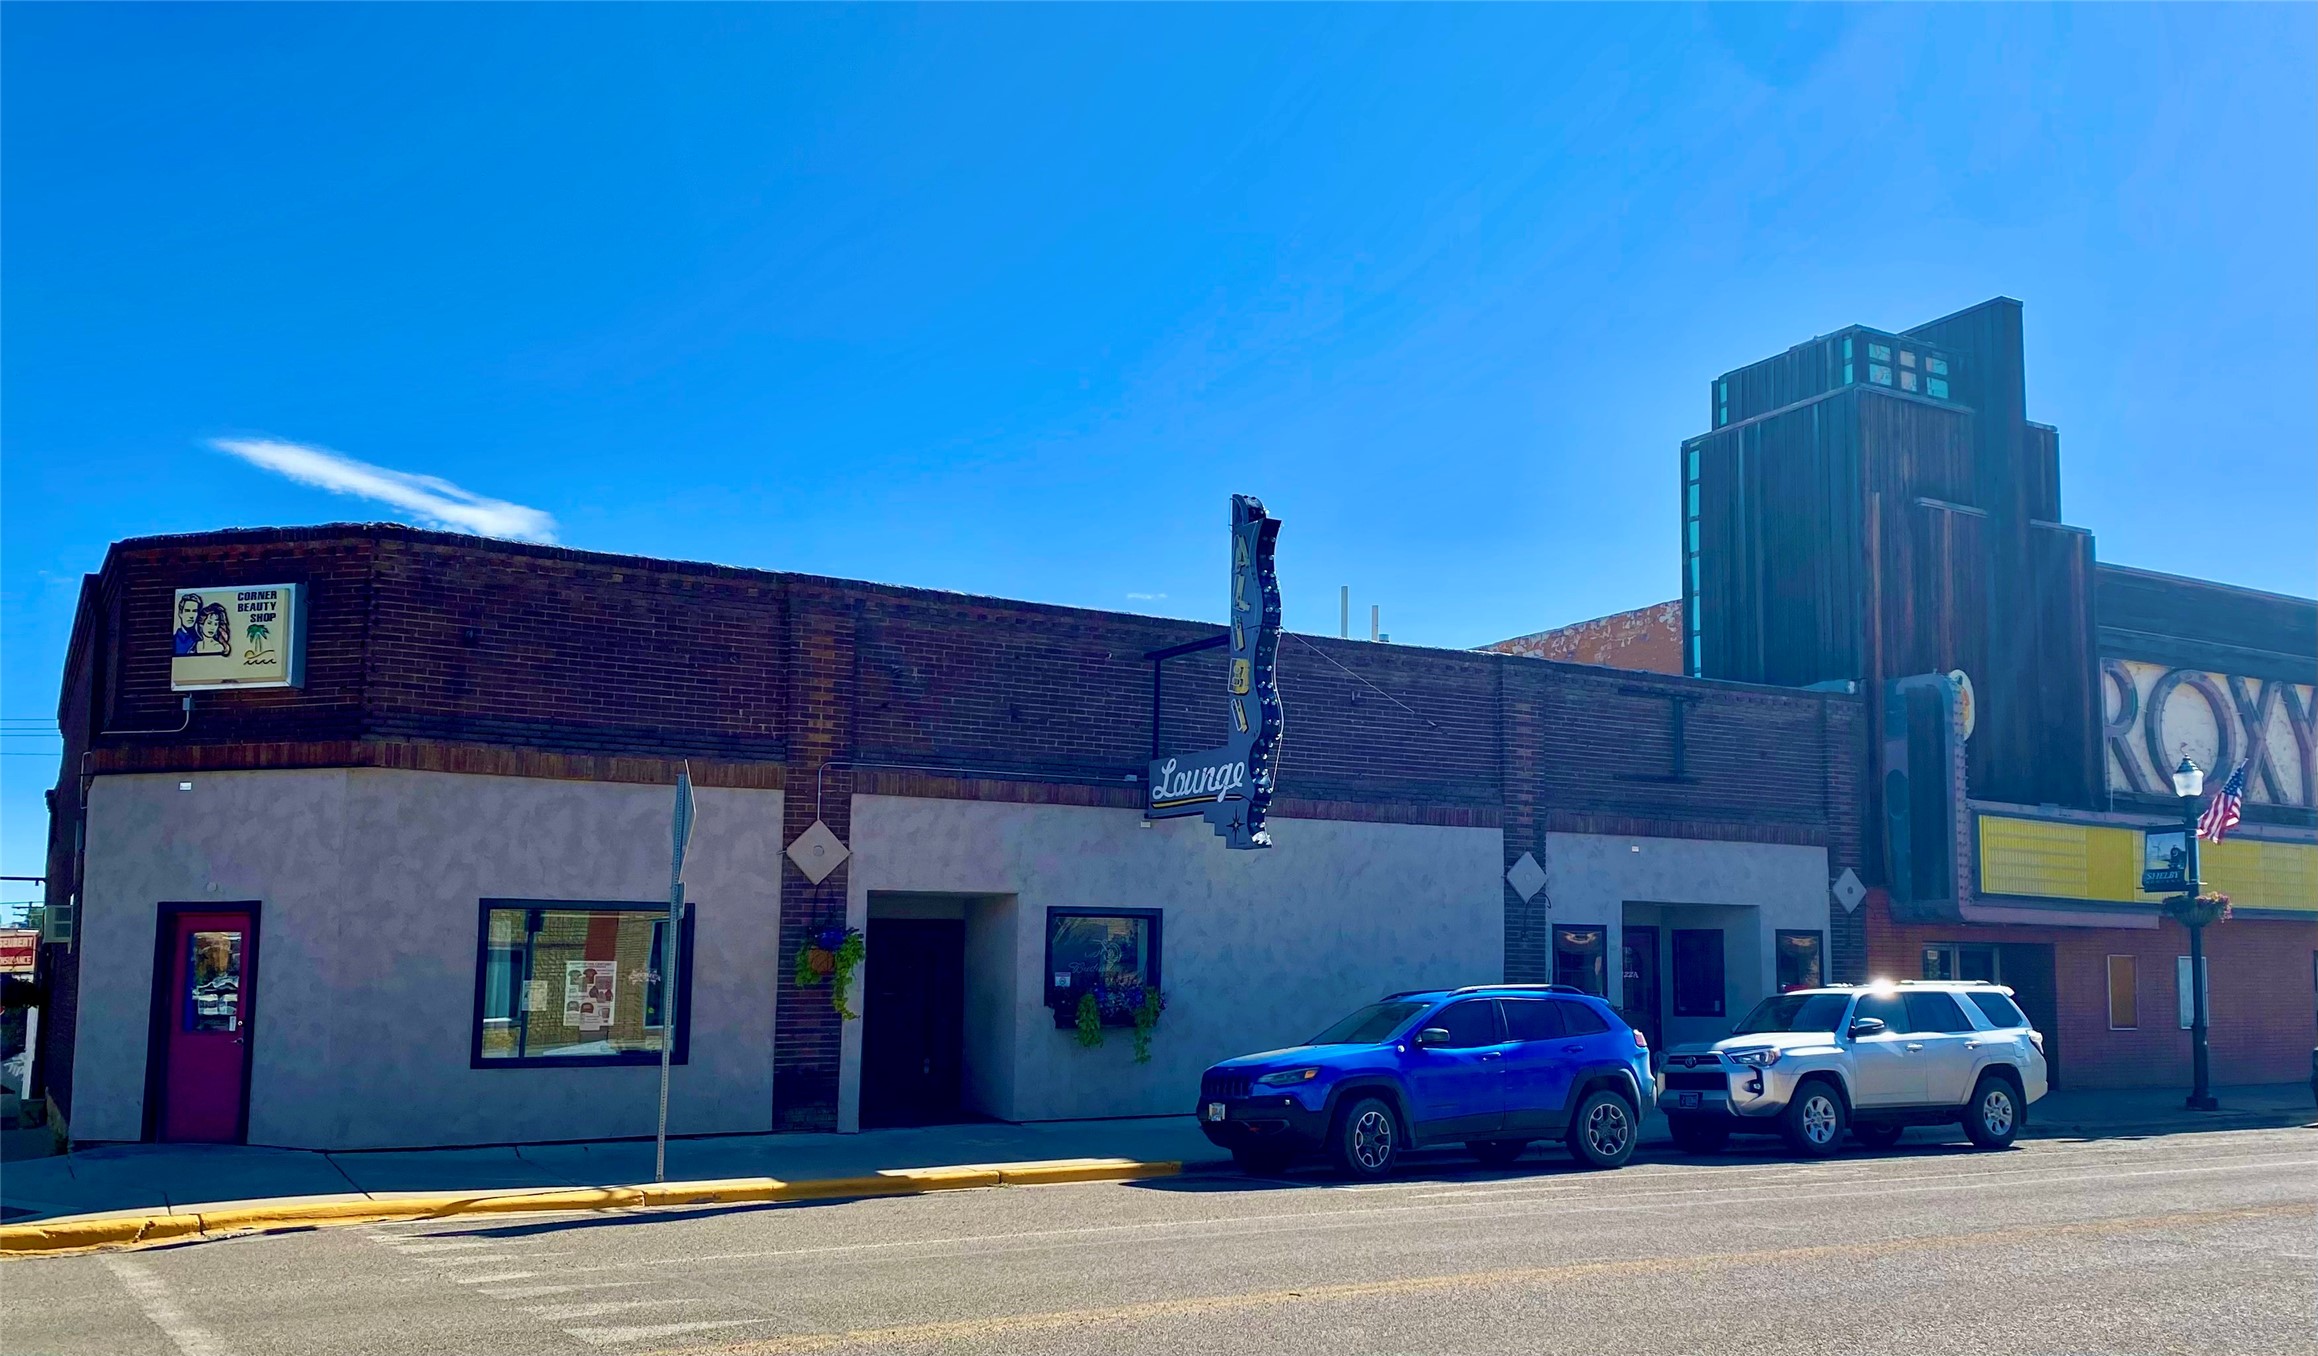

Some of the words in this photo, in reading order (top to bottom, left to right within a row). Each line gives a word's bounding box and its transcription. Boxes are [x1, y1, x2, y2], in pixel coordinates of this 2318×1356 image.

[237, 591, 277, 601] CORNER
[237, 602, 277, 612] BEAUTY
[250, 613, 276, 623] SHOP
[1228, 534, 1250, 734] ALIBI
[2100, 657, 2318, 807] ROXY
[1152, 758, 1245, 803] Lounge
[2146, 871, 2179, 880] SHELBY
[1623, 971, 1639, 979] ZZA
